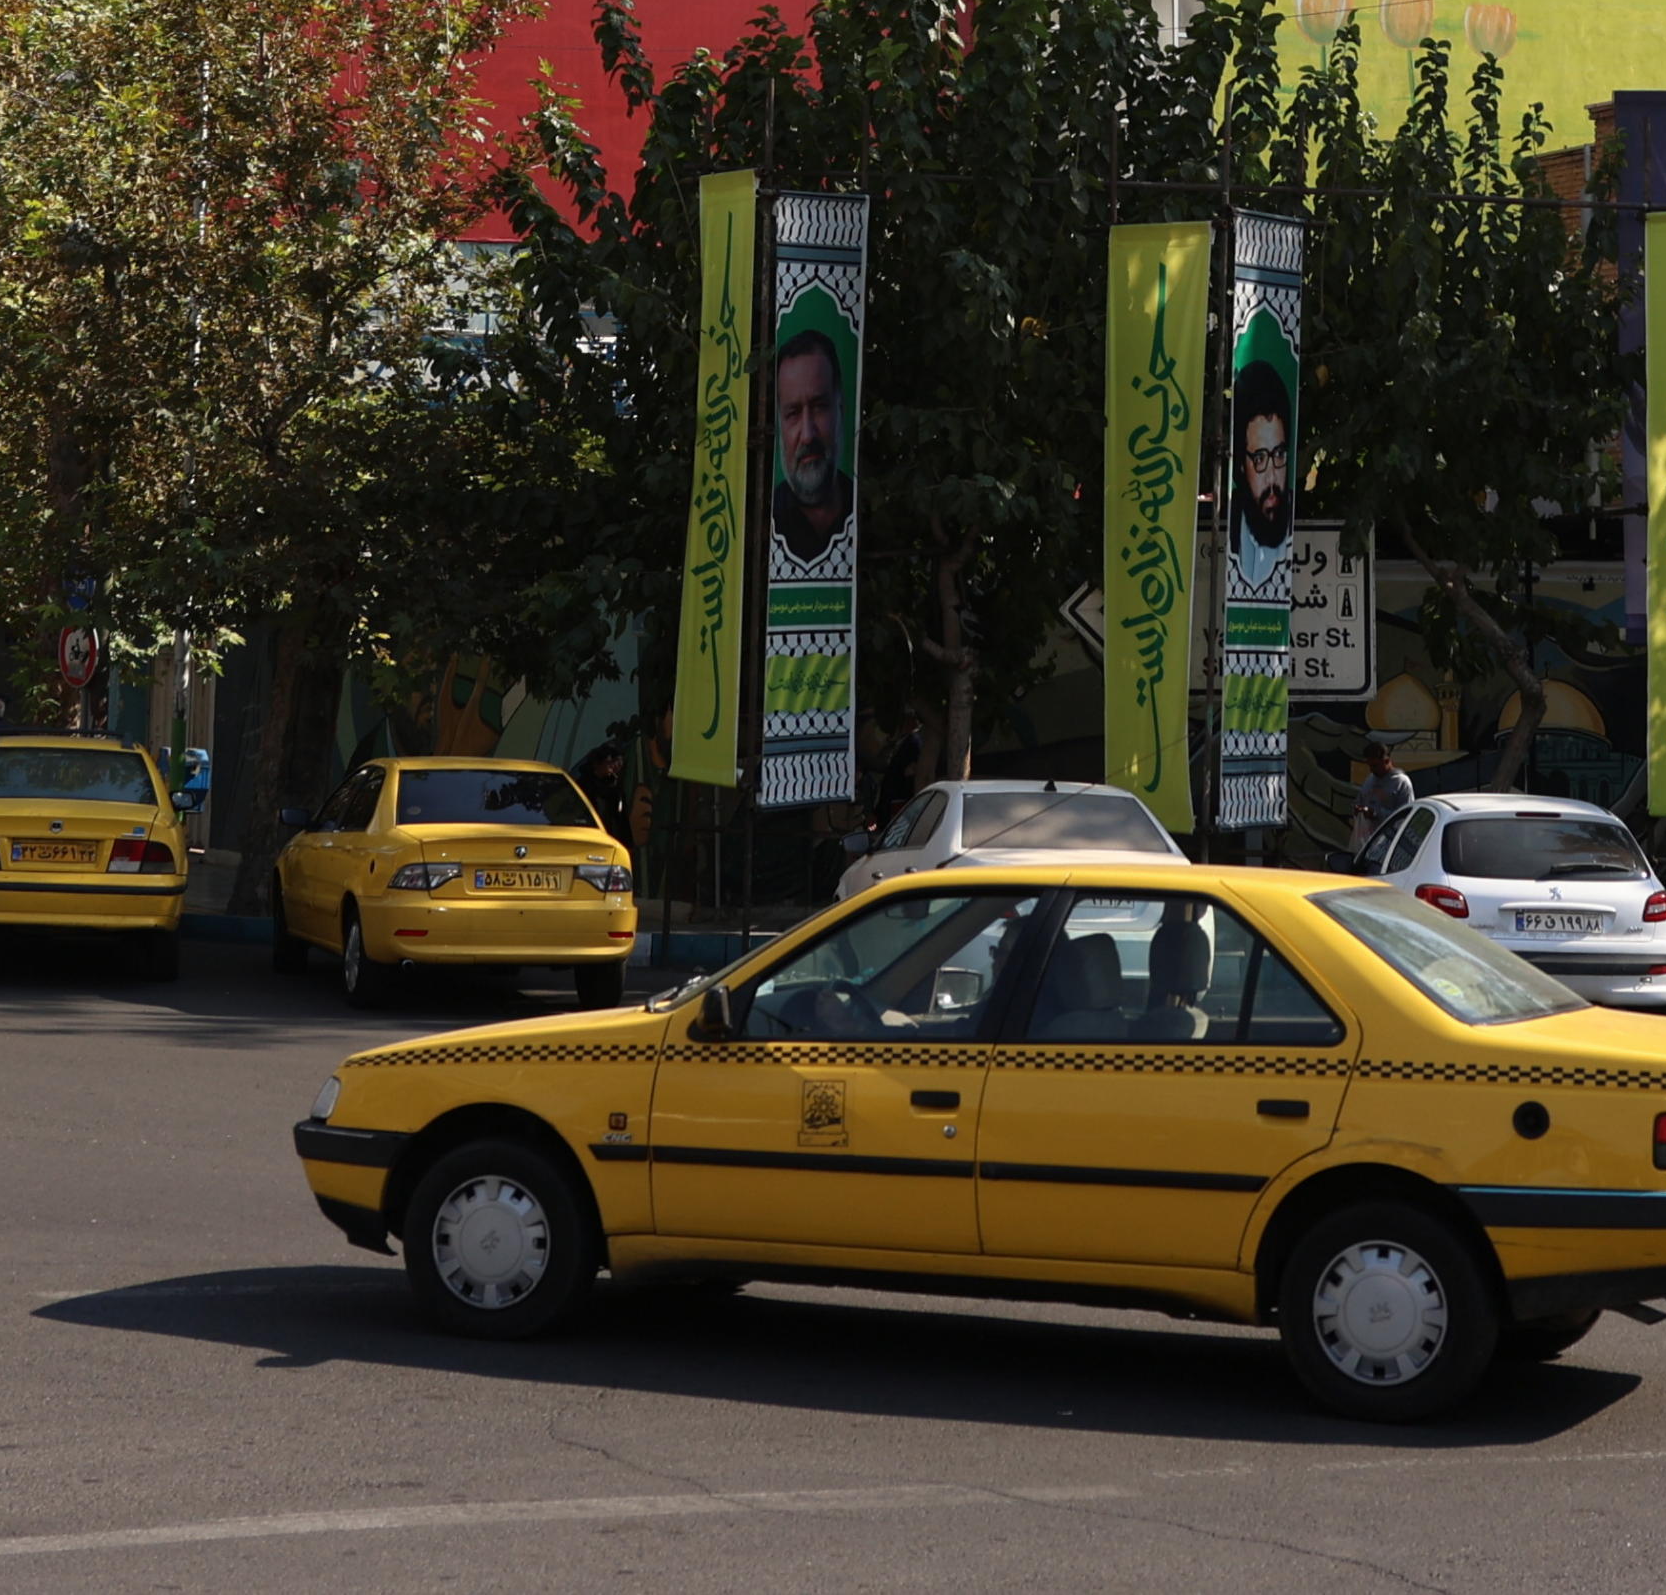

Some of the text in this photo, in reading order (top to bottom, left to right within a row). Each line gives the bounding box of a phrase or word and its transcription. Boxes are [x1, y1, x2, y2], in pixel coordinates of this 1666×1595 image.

[691, 561, 724, 740] است
[1304, 658, 1335, 678] St.
[1326, 628, 1355, 648] St.
[1121, 612, 1169, 793] است
